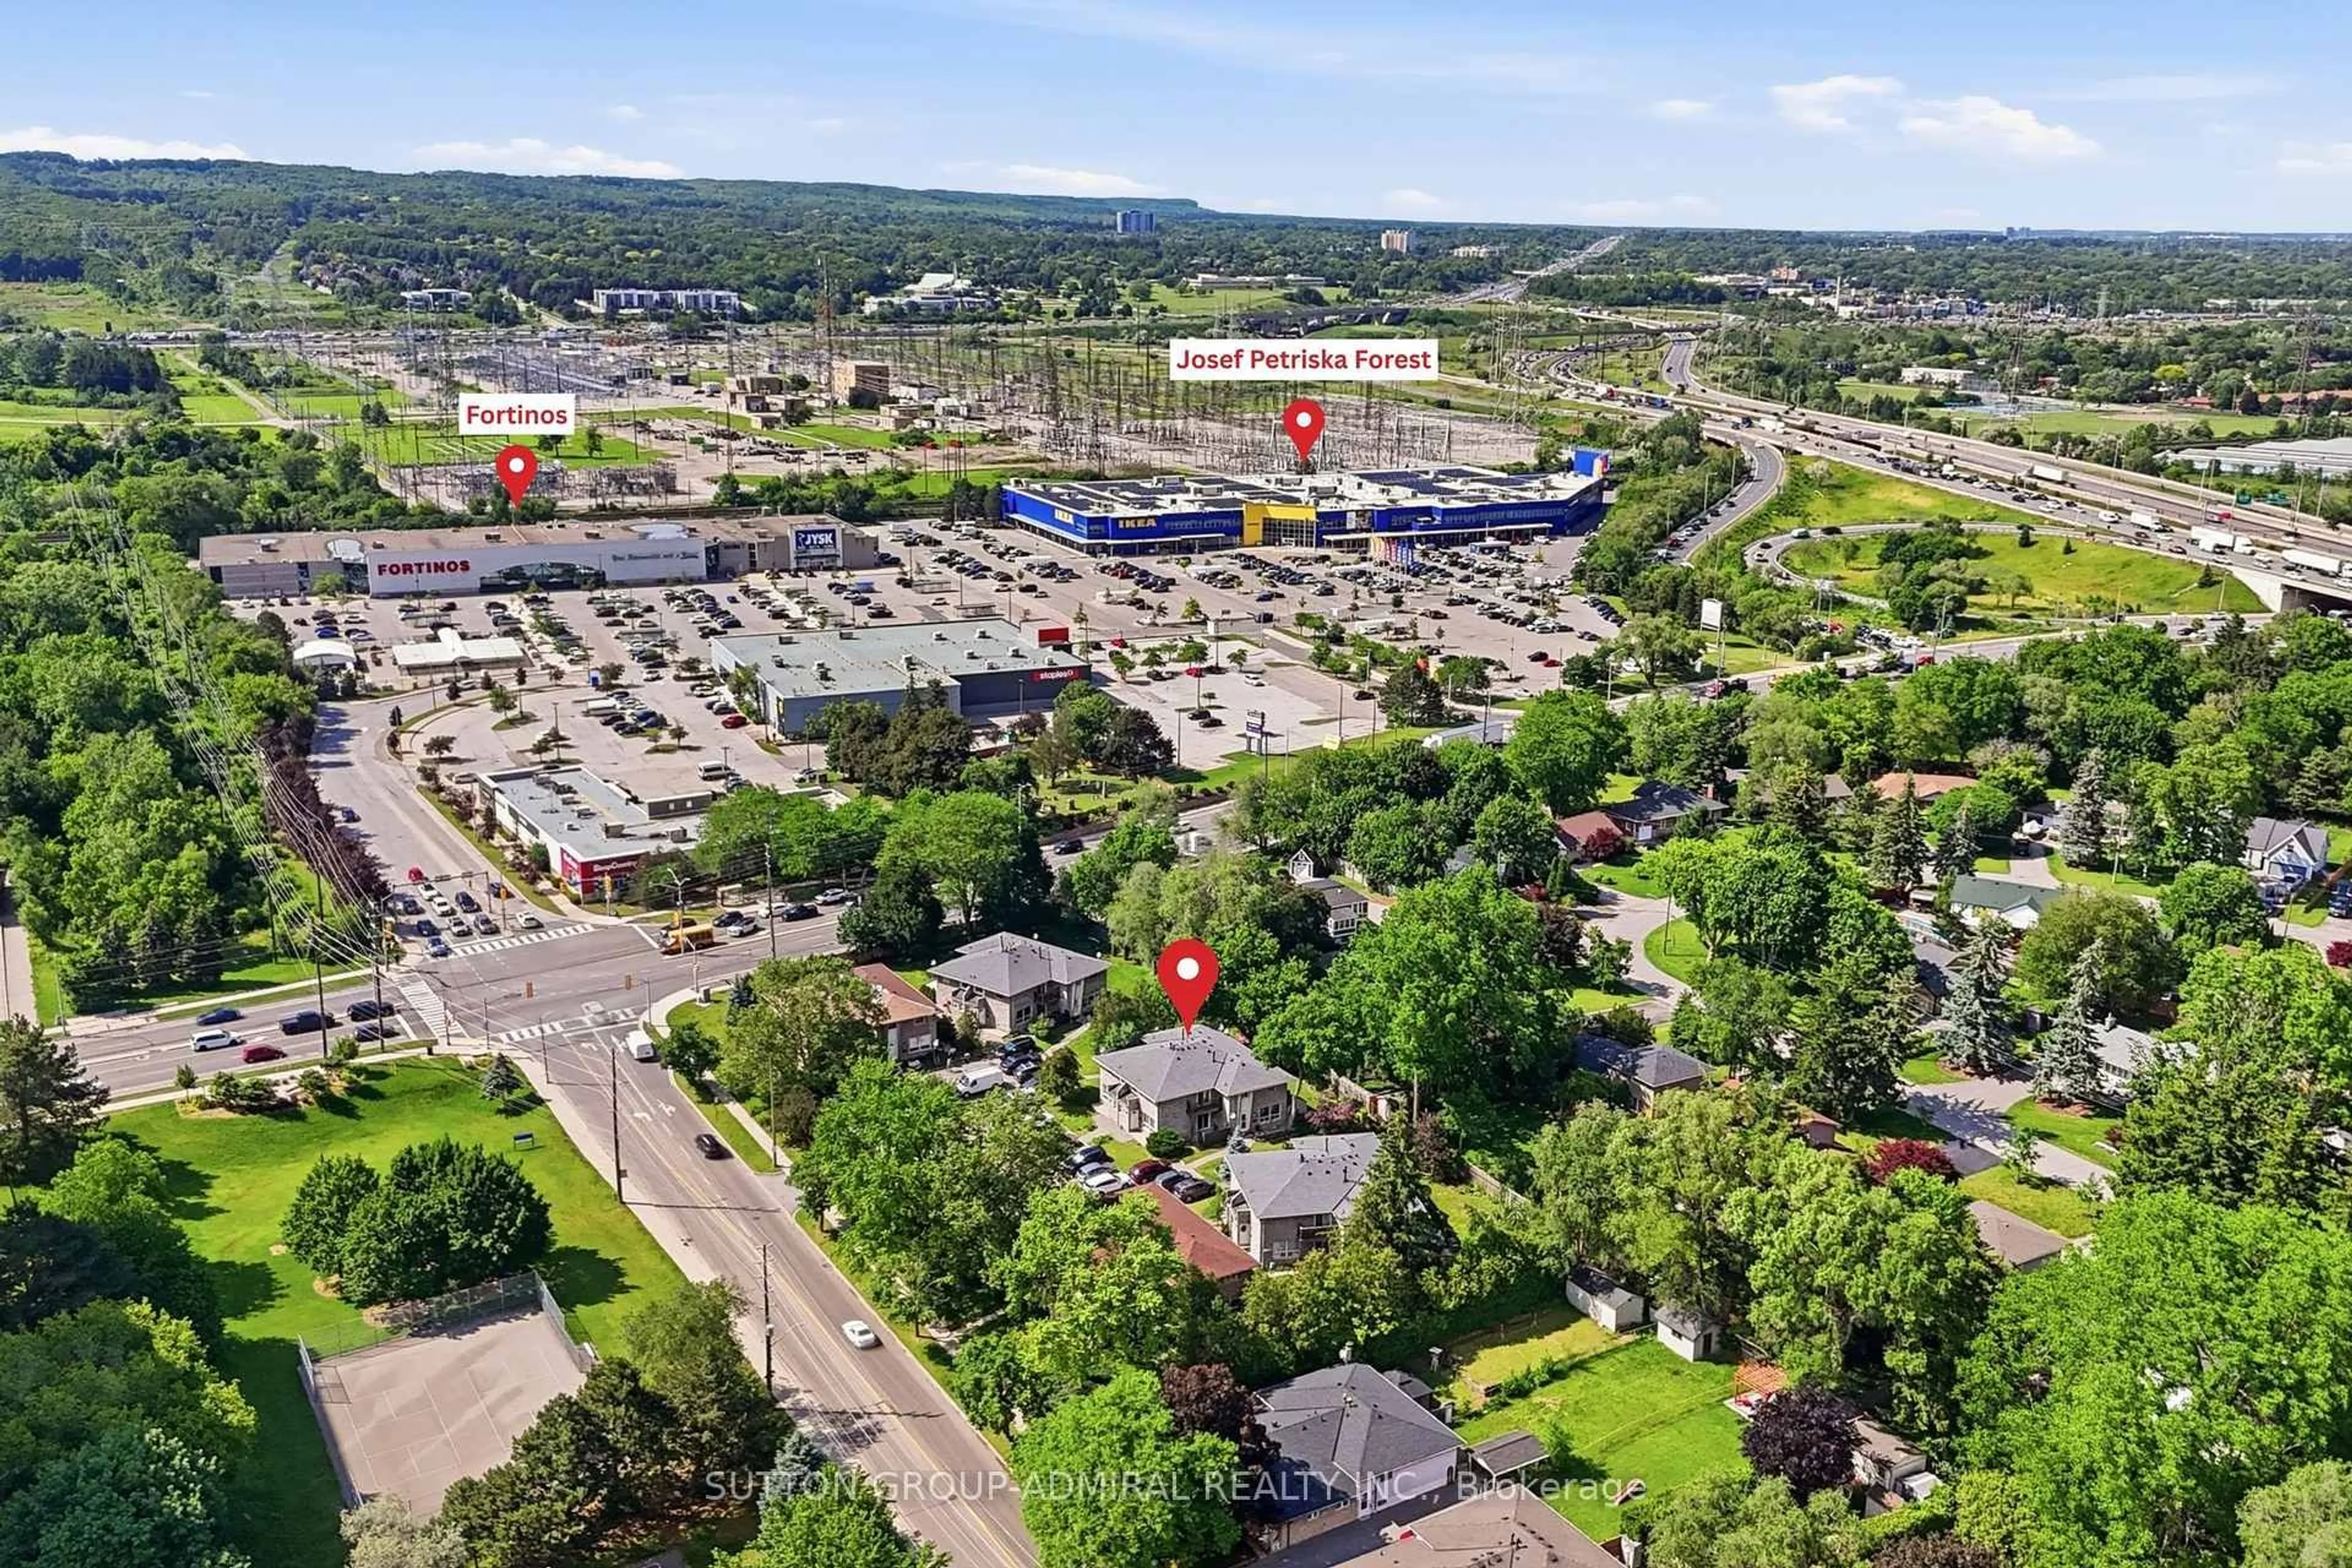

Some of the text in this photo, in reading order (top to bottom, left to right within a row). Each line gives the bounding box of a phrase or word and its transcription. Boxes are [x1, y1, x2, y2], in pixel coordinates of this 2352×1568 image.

[1118, 518, 1156, 529] IKEA
[805, 533, 833, 545] JYSK
[377, 560, 470, 576] FORTINOS
